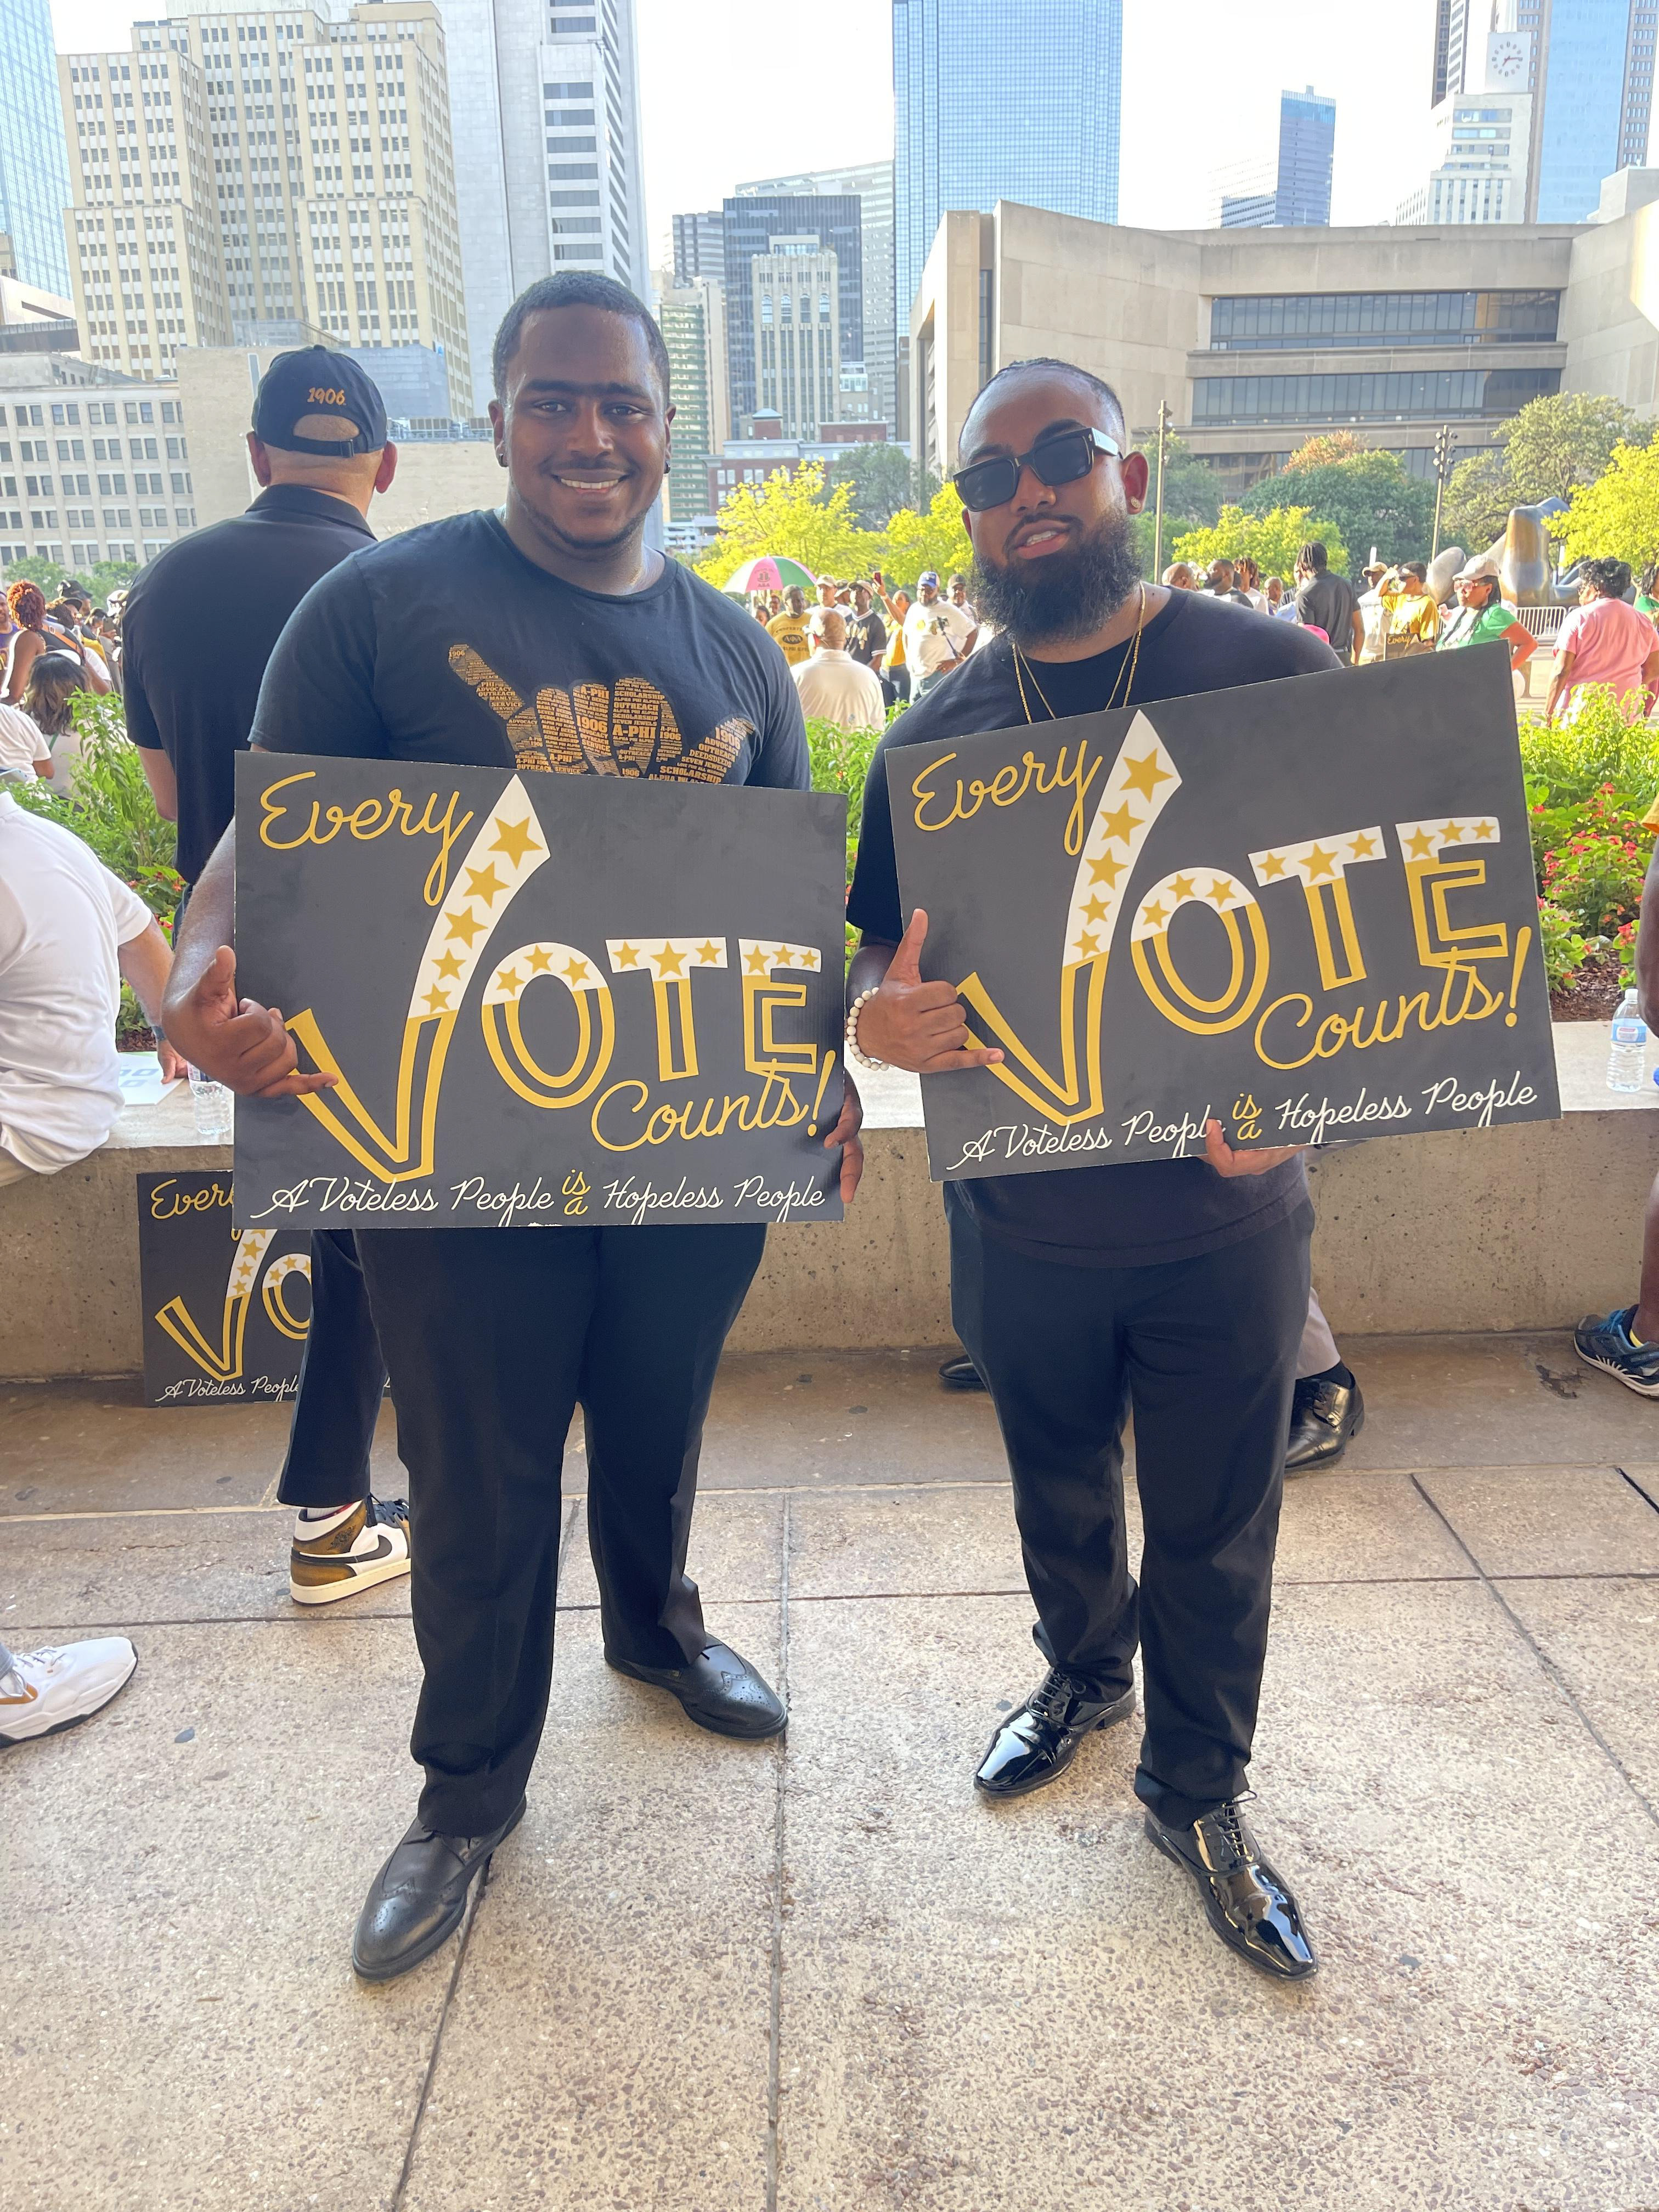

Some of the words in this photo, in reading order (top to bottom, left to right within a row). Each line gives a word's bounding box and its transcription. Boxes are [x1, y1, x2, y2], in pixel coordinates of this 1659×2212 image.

[307, 387, 345, 405] 1906
[580, 686, 610, 699] A-PHI
[614, 691, 665, 700] SCHOLARSHIP
[613, 713, 658, 721] SCHOLARSHIP
[614, 702, 658, 711] OUTREACH
[577, 715, 608, 733] 1906
[579, 727, 608, 739] ADVOCACY
[612, 724, 657, 739] A-PHI
[580, 733, 609, 745] OUTREACH
[582, 738, 611, 753] SERVICE
[660, 731, 681, 741] 1906
[704, 737, 739, 757] ADVOCACY
[715, 727, 741, 750] 1906
[550, 753, 573, 763] A-PHI
[689, 749, 732, 768] DEEDSDEEDS
[698, 743, 736, 762] OUTREACH
[622, 768, 640, 777] 1906
[660, 766, 721, 783] SCHOLARSHIP
[681, 757, 703, 766] SEVEN
[705, 761, 727, 773] JEWELS
[911, 740, 1104, 856] Every
[259, 771, 473, 906] Every
[957, 709, 1509, 1127] VOTE
[285, 773, 822, 1182] VOTE
[1255, 926, 1532, 1071] Counts!
[591, 1050, 836, 1152] Counts!
[1232, 1093, 1262, 1121] is
[1421, 1070, 1537, 1127] People
[1275, 1087, 1412, 1144] Hopeless
[994, 1120, 1113, 1159] Voteless
[1237, 1120, 1262, 1141] a
[946, 1130, 995, 1171] A
[562, 1169, 591, 1195] is
[250, 1179, 309, 1218] A
[309, 1176, 439, 1211] Voteless
[450, 1176, 554, 1227] People
[603, 1176, 724, 1225] Hopeless
[734, 1175, 825, 1223] People
[564, 1197, 588, 1215] a
[154, 1229, 312, 1381] VO
[155, 1380, 183, 1402] A
[183, 1378, 246, 1397] Voteless
